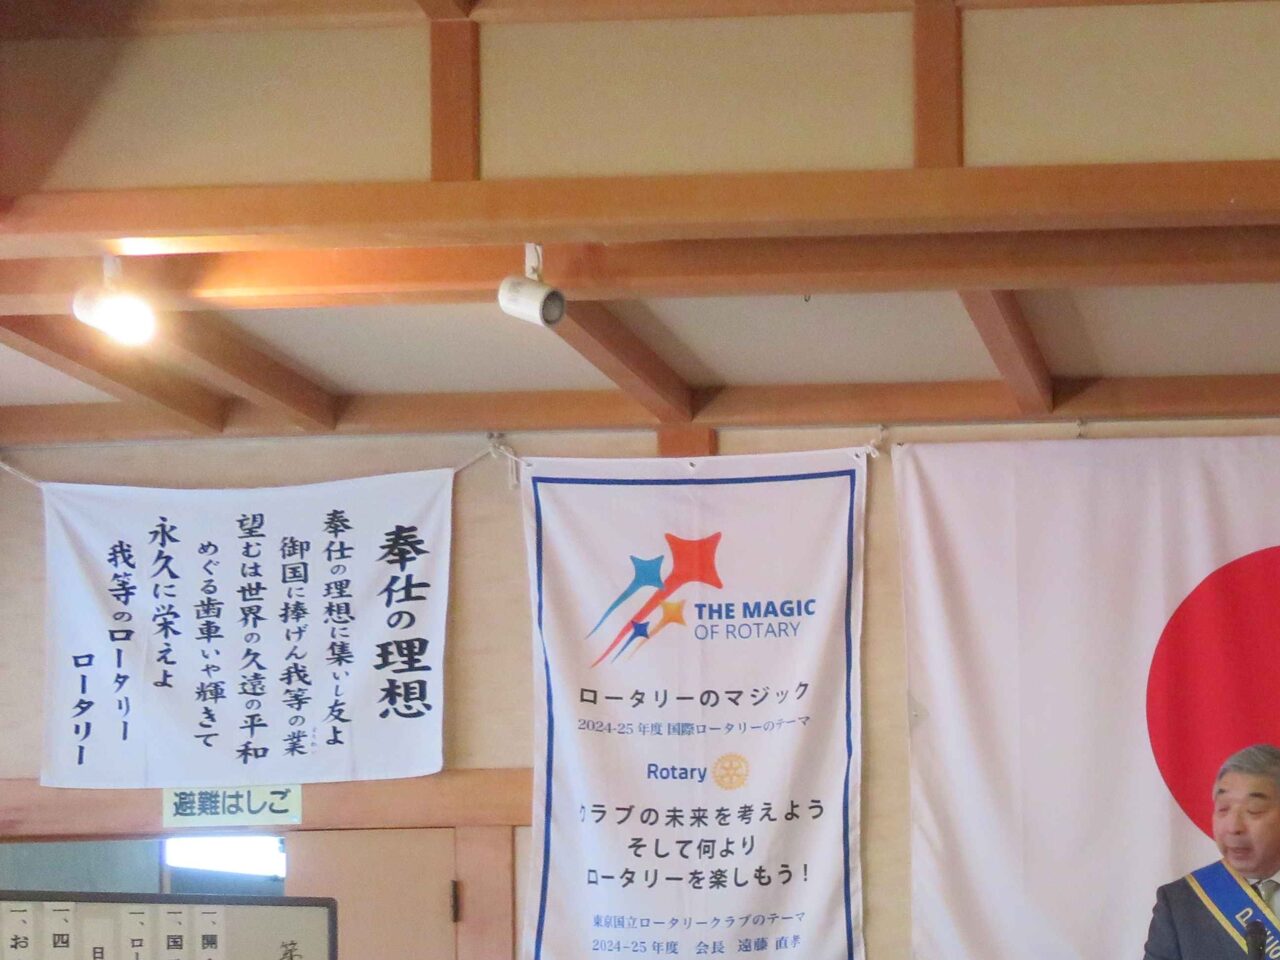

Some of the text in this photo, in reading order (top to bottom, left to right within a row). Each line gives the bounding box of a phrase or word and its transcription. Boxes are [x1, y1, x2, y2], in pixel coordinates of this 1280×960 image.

[148, 516, 181, 688] 永久に栄えよ
[694, 599, 816, 620] THE MAGIC
[322, 509, 355, 745] 奉仕の理想に集いし友よ
[373, 525, 432, 719] 奉仕の理想
[694, 622, 800, 640] OF ROTARY
[107, 540, 137, 741] 我等のロータリー
[194, 541, 227, 747] めぐる歯車いや輝きて
[235, 513, 269, 764] 望むは世界の久遠の平和
[278, 536, 312, 756] 御国に捧げん我等の業
[72, 653, 95, 765] ロータリー
[580, 682, 809, 708] ロータリーのマジック
[578, 715, 811, 736] 2024-25 年度 国際ロータリーのテーマ
[647, 763, 707, 783] Rotary
[173, 788, 291, 816] 避難はしご
[628, 835, 755, 859] そして何より
[593, 912, 805, 930] 東京国立ロータリークラブのテーマ
[592, 939, 647, 953] 2024-25
[652, 940, 678, 955] 年度
[695, 940, 725, 955] 会長
